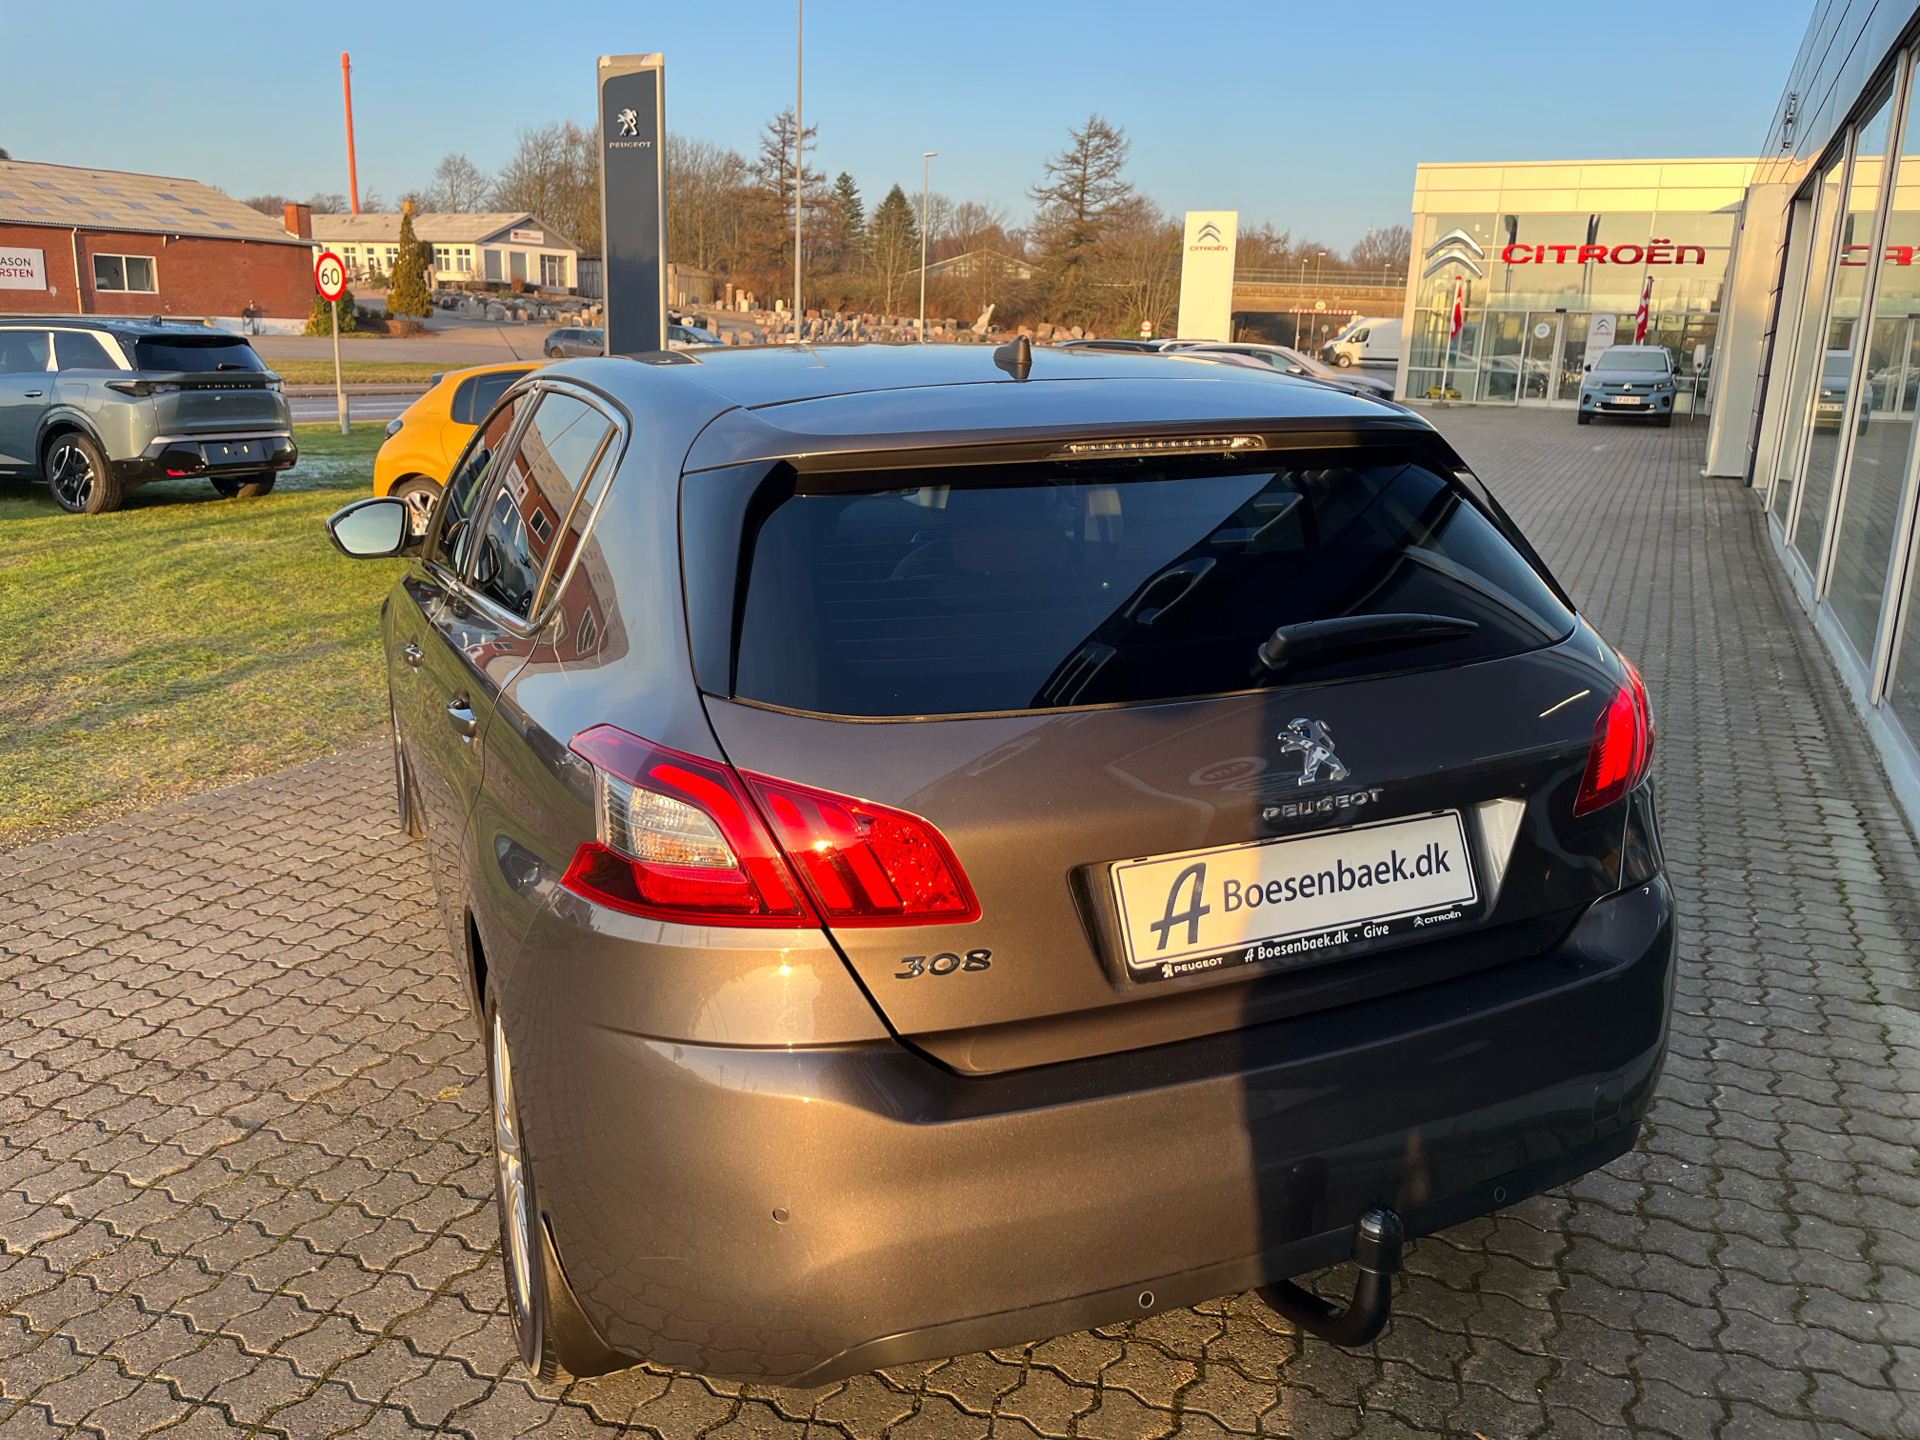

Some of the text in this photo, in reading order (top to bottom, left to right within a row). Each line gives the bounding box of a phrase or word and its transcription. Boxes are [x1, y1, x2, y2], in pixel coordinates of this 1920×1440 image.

[609, 141, 652, 149] PEUGEOT
[321, 268, 340, 286] 60
[1262, 788, 1384, 820] PEUGEOT
[1223, 842, 1451, 912] Boesenbaek.dk
[1257, 930, 1350, 961] Boesenbaek.dk
[1363, 924, 1390, 939] Give
[894, 949, 992, 979] 308
[1174, 957, 1223, 973] PEUGEOT
